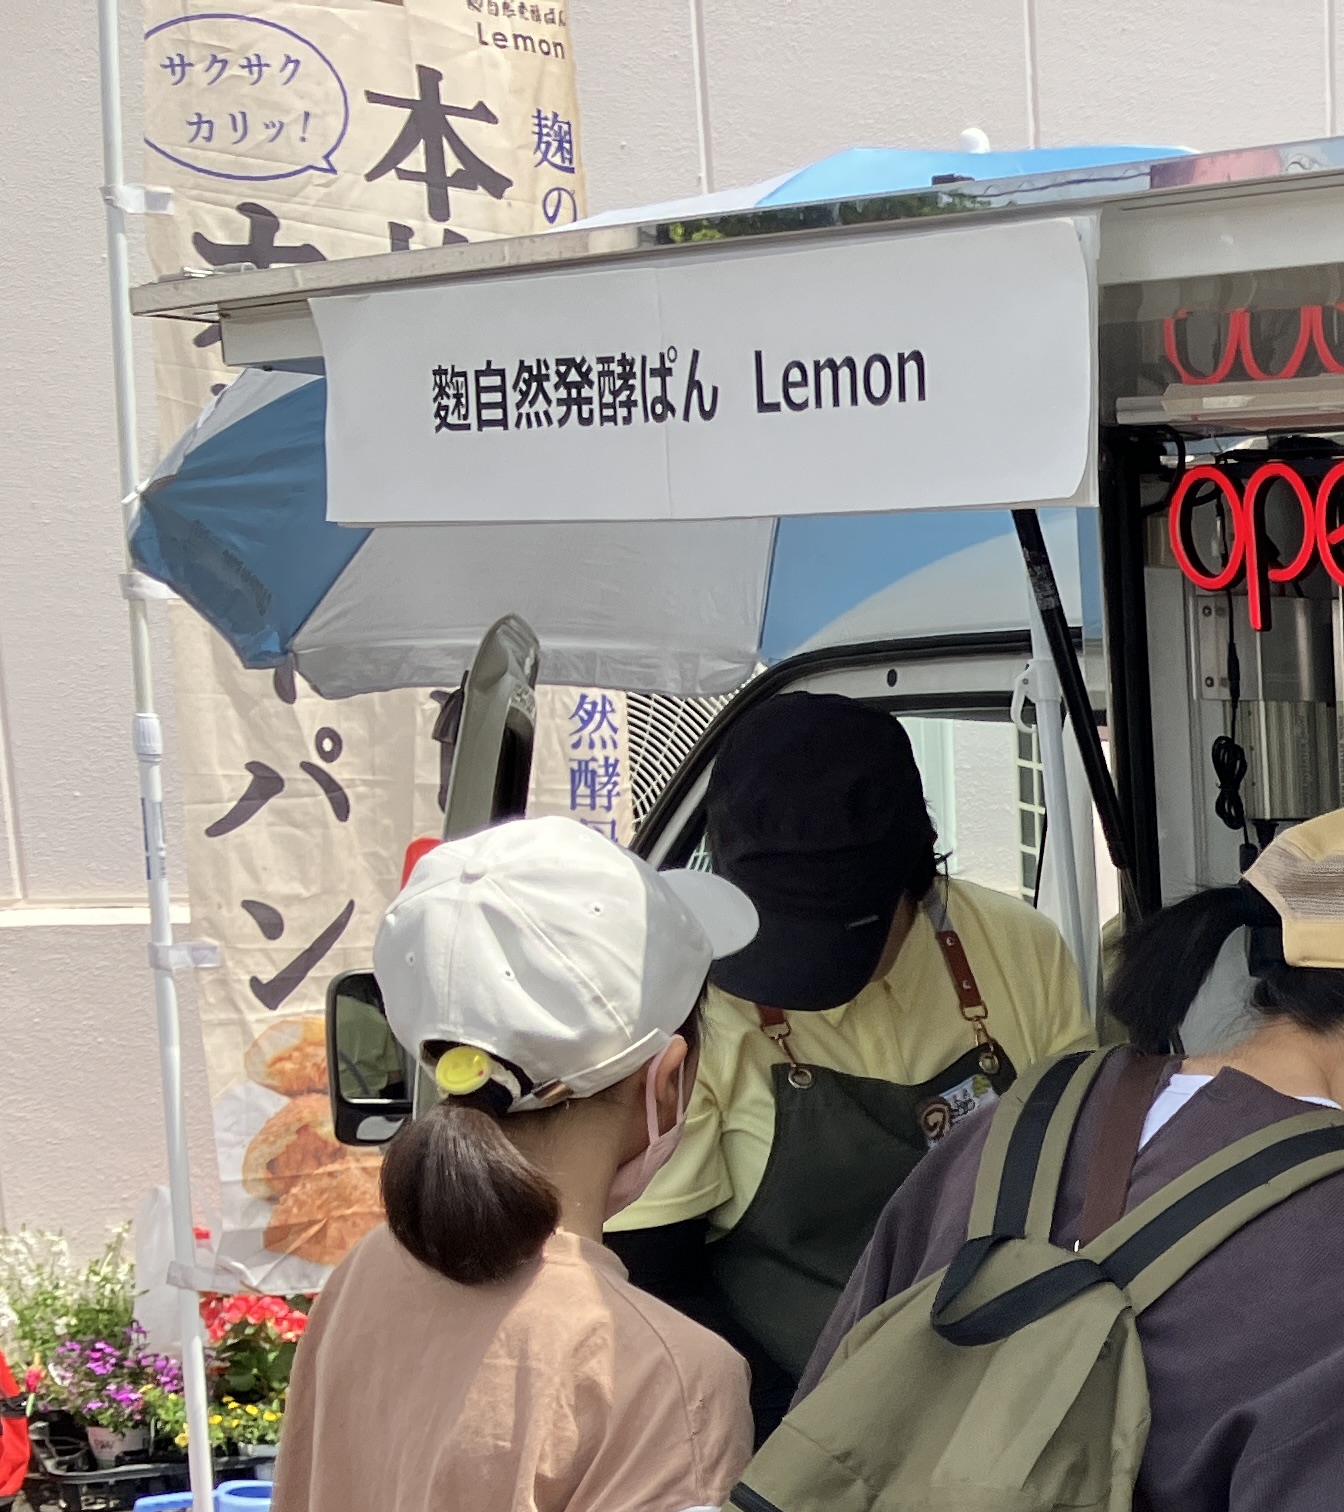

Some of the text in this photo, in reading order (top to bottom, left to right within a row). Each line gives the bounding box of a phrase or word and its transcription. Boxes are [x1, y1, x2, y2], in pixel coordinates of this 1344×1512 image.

[476, 21, 566, 60] Lemon
[159, 52, 304, 88] サクサク
[753, 348, 928, 415] Lemon
